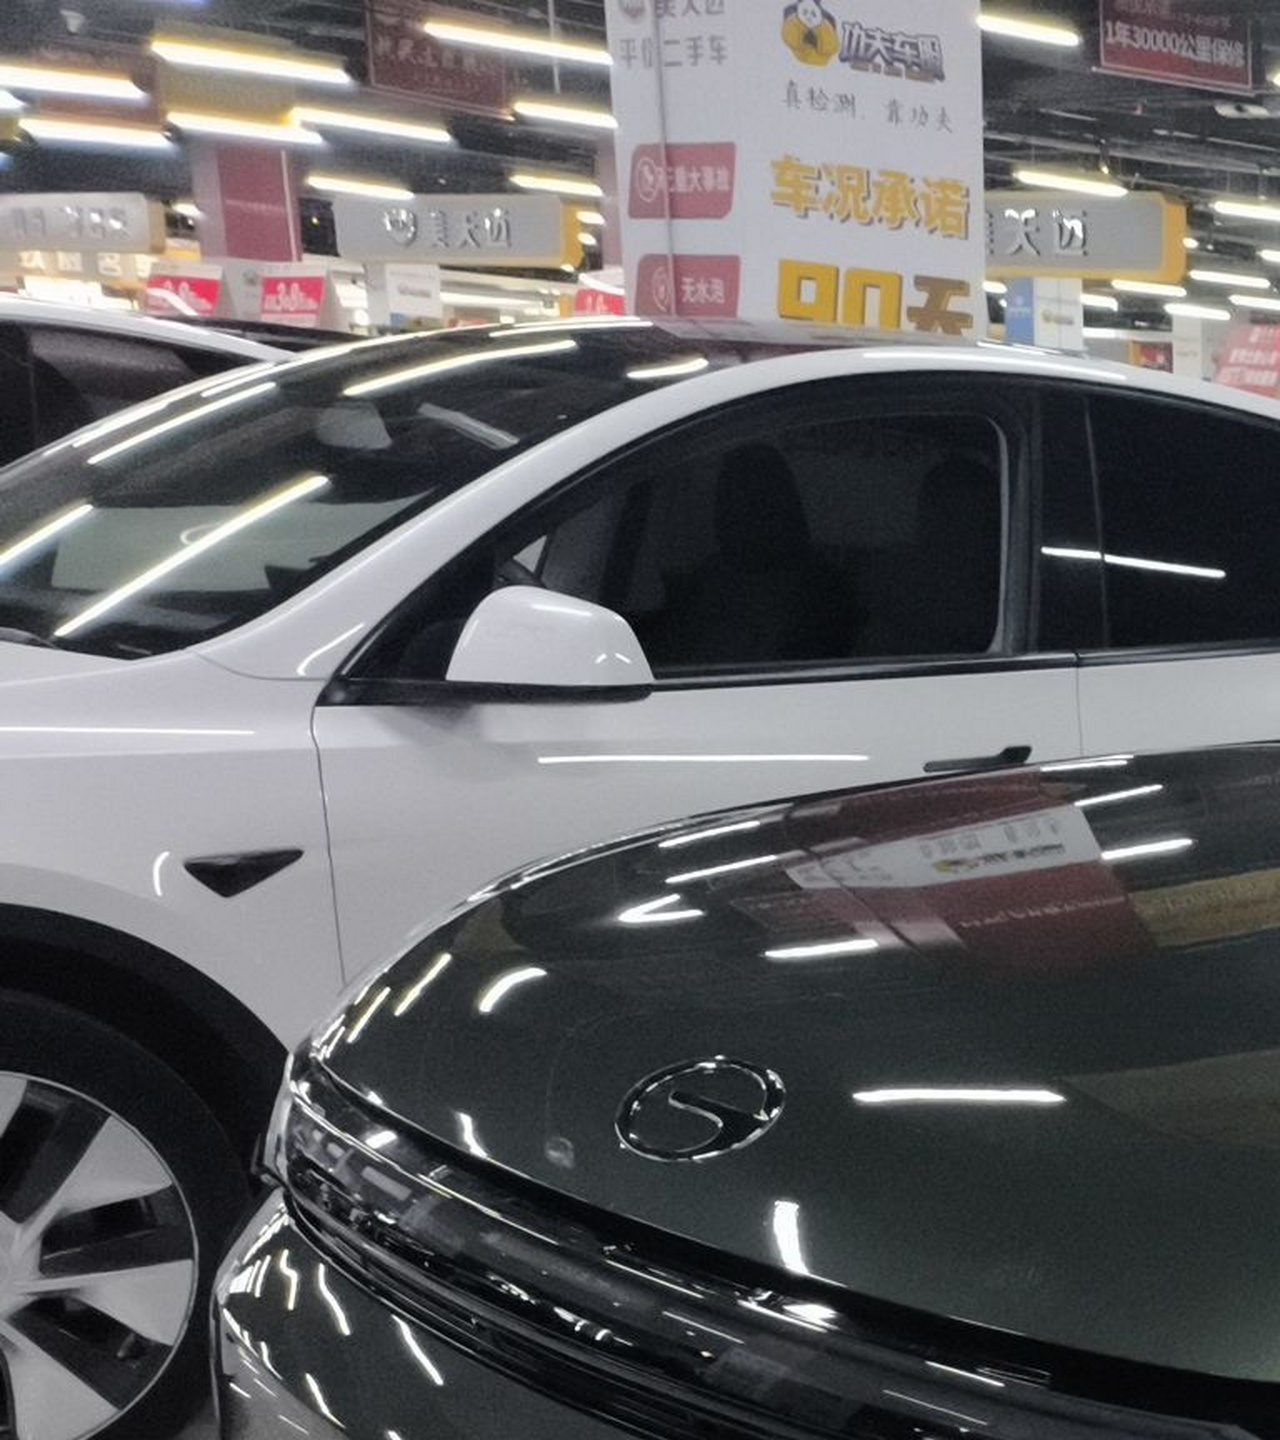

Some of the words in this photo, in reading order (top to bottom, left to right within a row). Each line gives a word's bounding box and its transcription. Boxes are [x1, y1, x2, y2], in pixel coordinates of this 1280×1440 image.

[770, 153, 970, 240] 车况承诺
[987, 207, 1089, 257] 天迈
[778, 258, 974, 336] 90天
